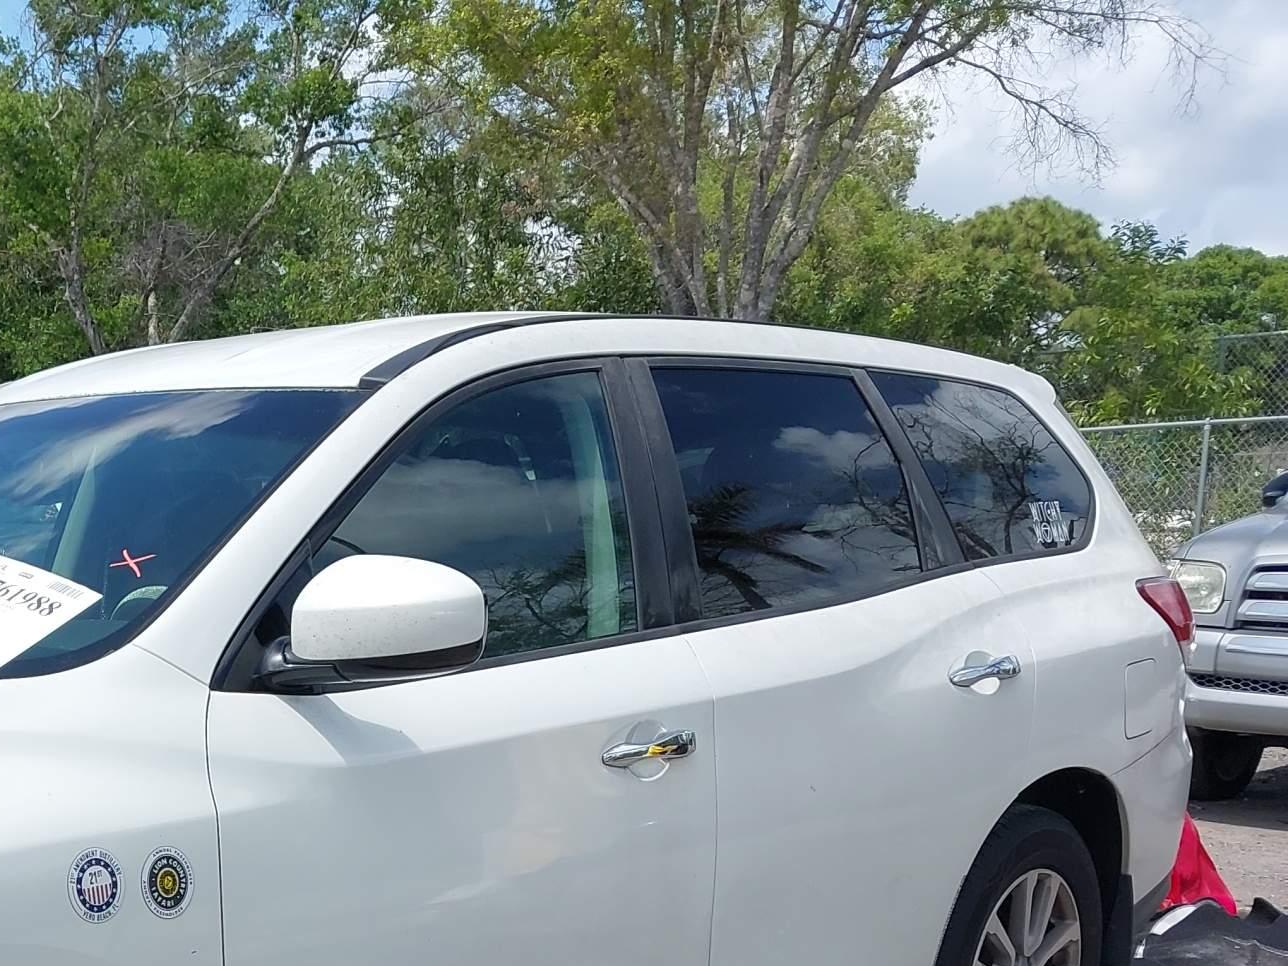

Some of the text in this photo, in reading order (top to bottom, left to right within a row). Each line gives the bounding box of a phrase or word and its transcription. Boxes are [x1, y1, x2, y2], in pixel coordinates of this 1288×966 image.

[1028, 501, 1061, 522] WITCHY
[1033, 521, 1070, 543] WOMAN
[153, 858, 186, 895] LION COUNTRY
